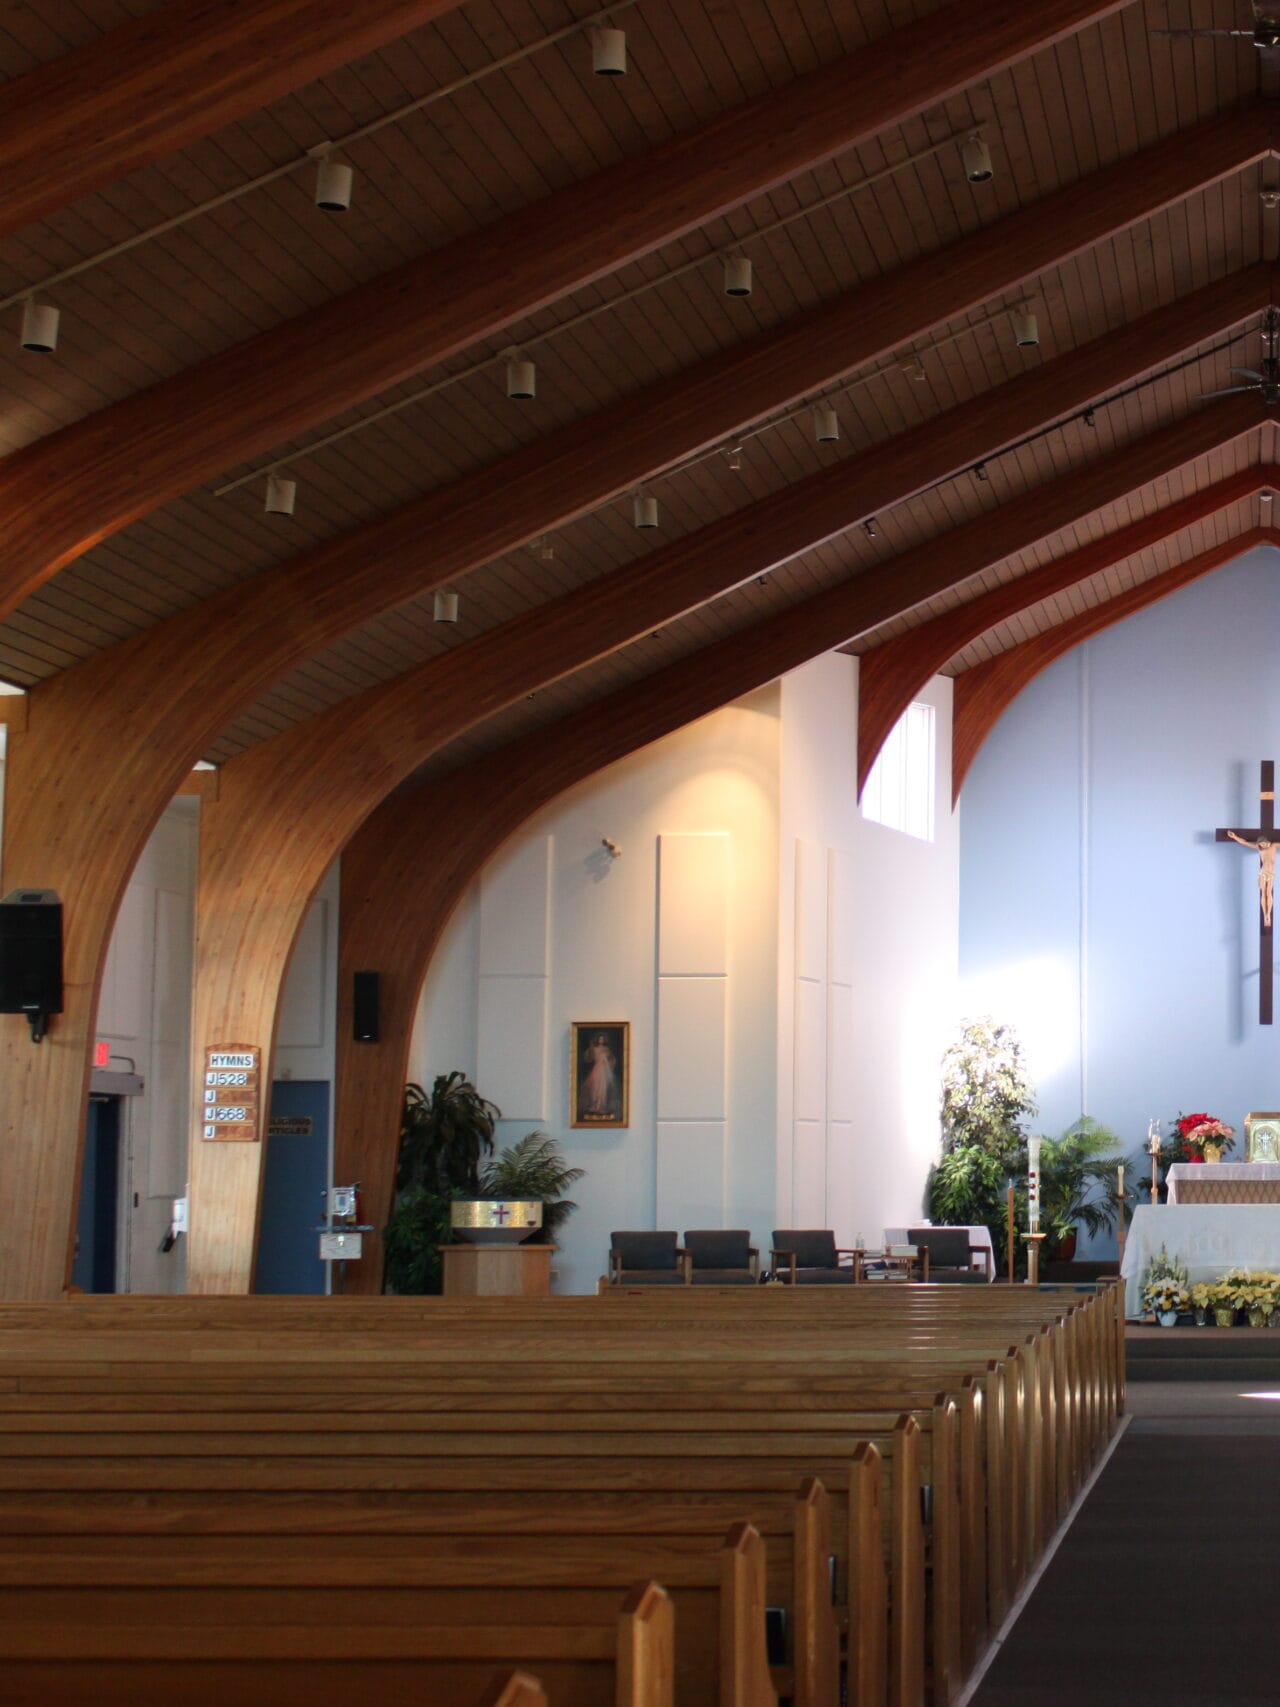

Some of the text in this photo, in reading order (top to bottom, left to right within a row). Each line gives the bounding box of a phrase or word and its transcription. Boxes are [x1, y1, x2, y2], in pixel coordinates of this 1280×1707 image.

[211, 1055, 252, 1066] HYMNS
[218, 1073, 247, 1085] 528
[207, 1091, 214, 1101] J
[206, 1127, 214, 1137] J
